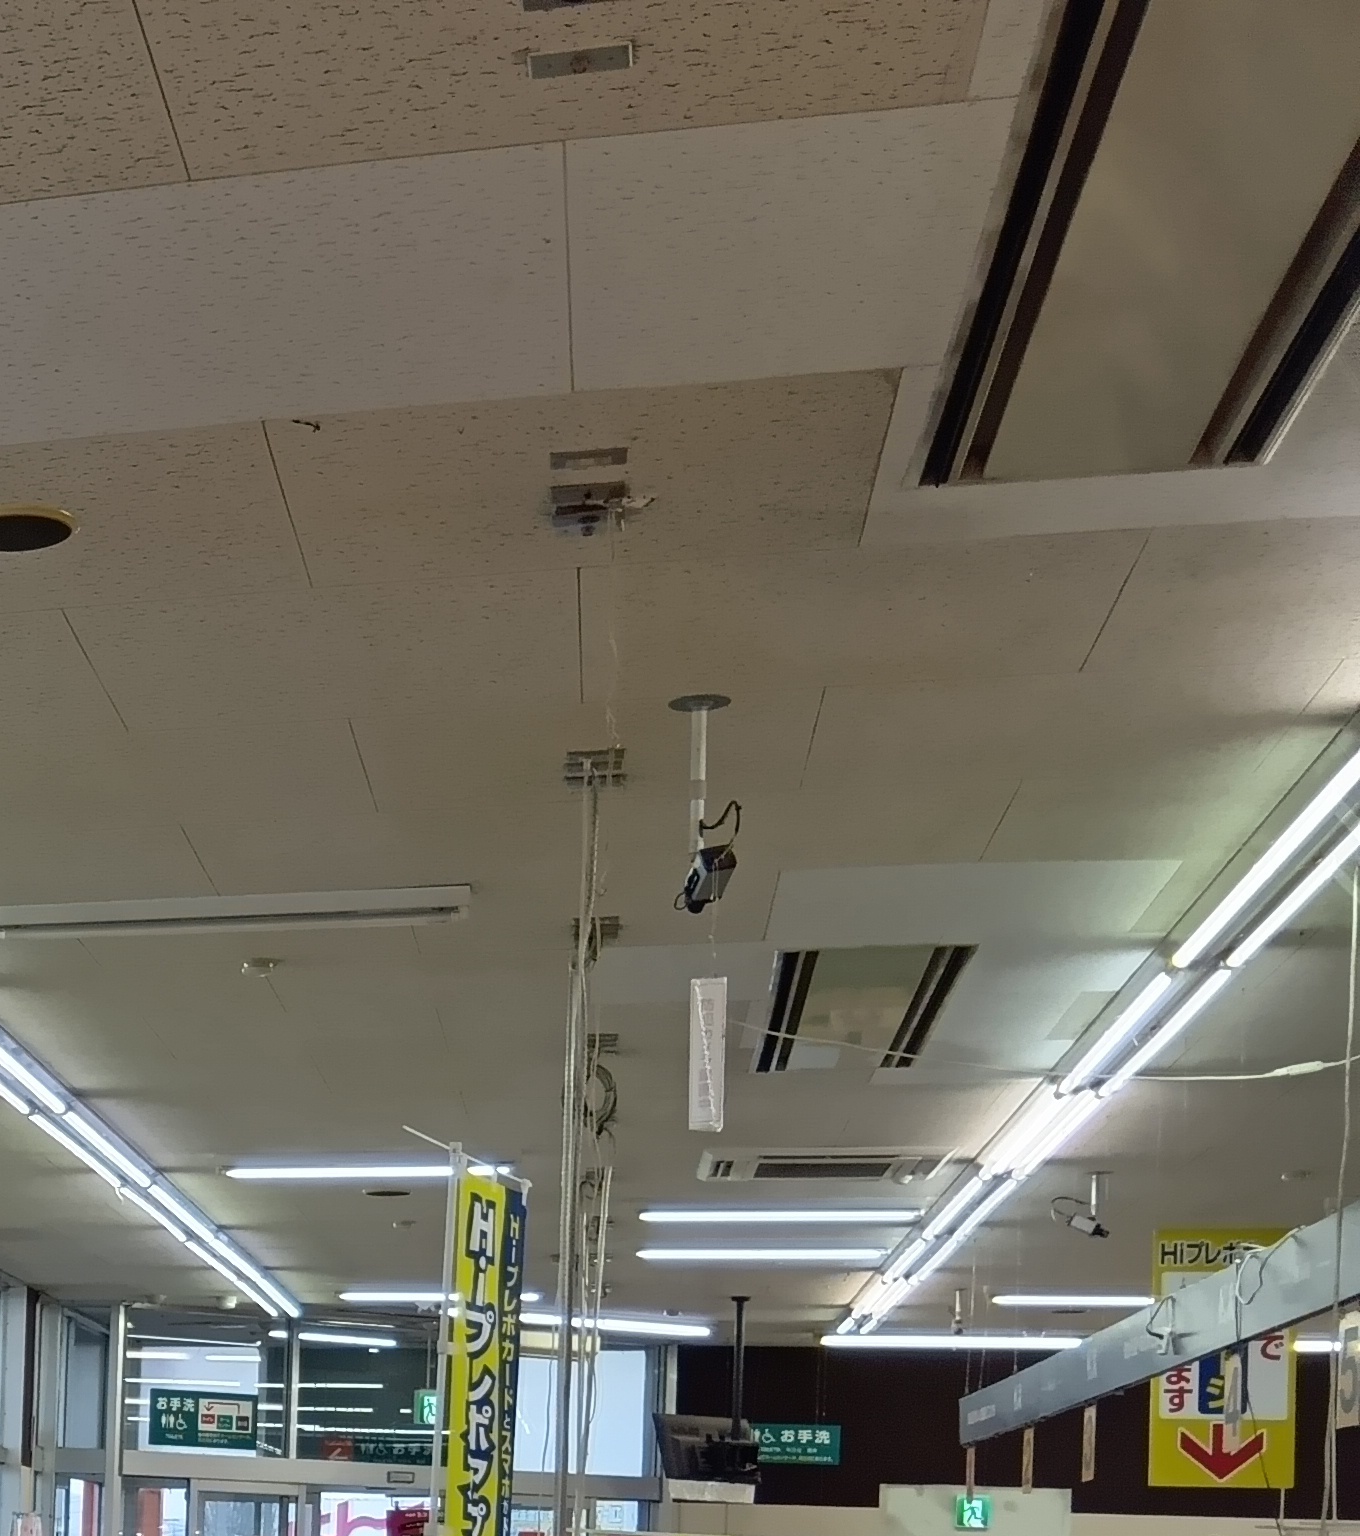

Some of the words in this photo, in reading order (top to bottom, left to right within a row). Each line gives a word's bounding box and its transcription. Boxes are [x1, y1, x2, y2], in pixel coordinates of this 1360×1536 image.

[156, 1397, 194, 1412] お手洗
[781, 1430, 830, 1444] お手洗
